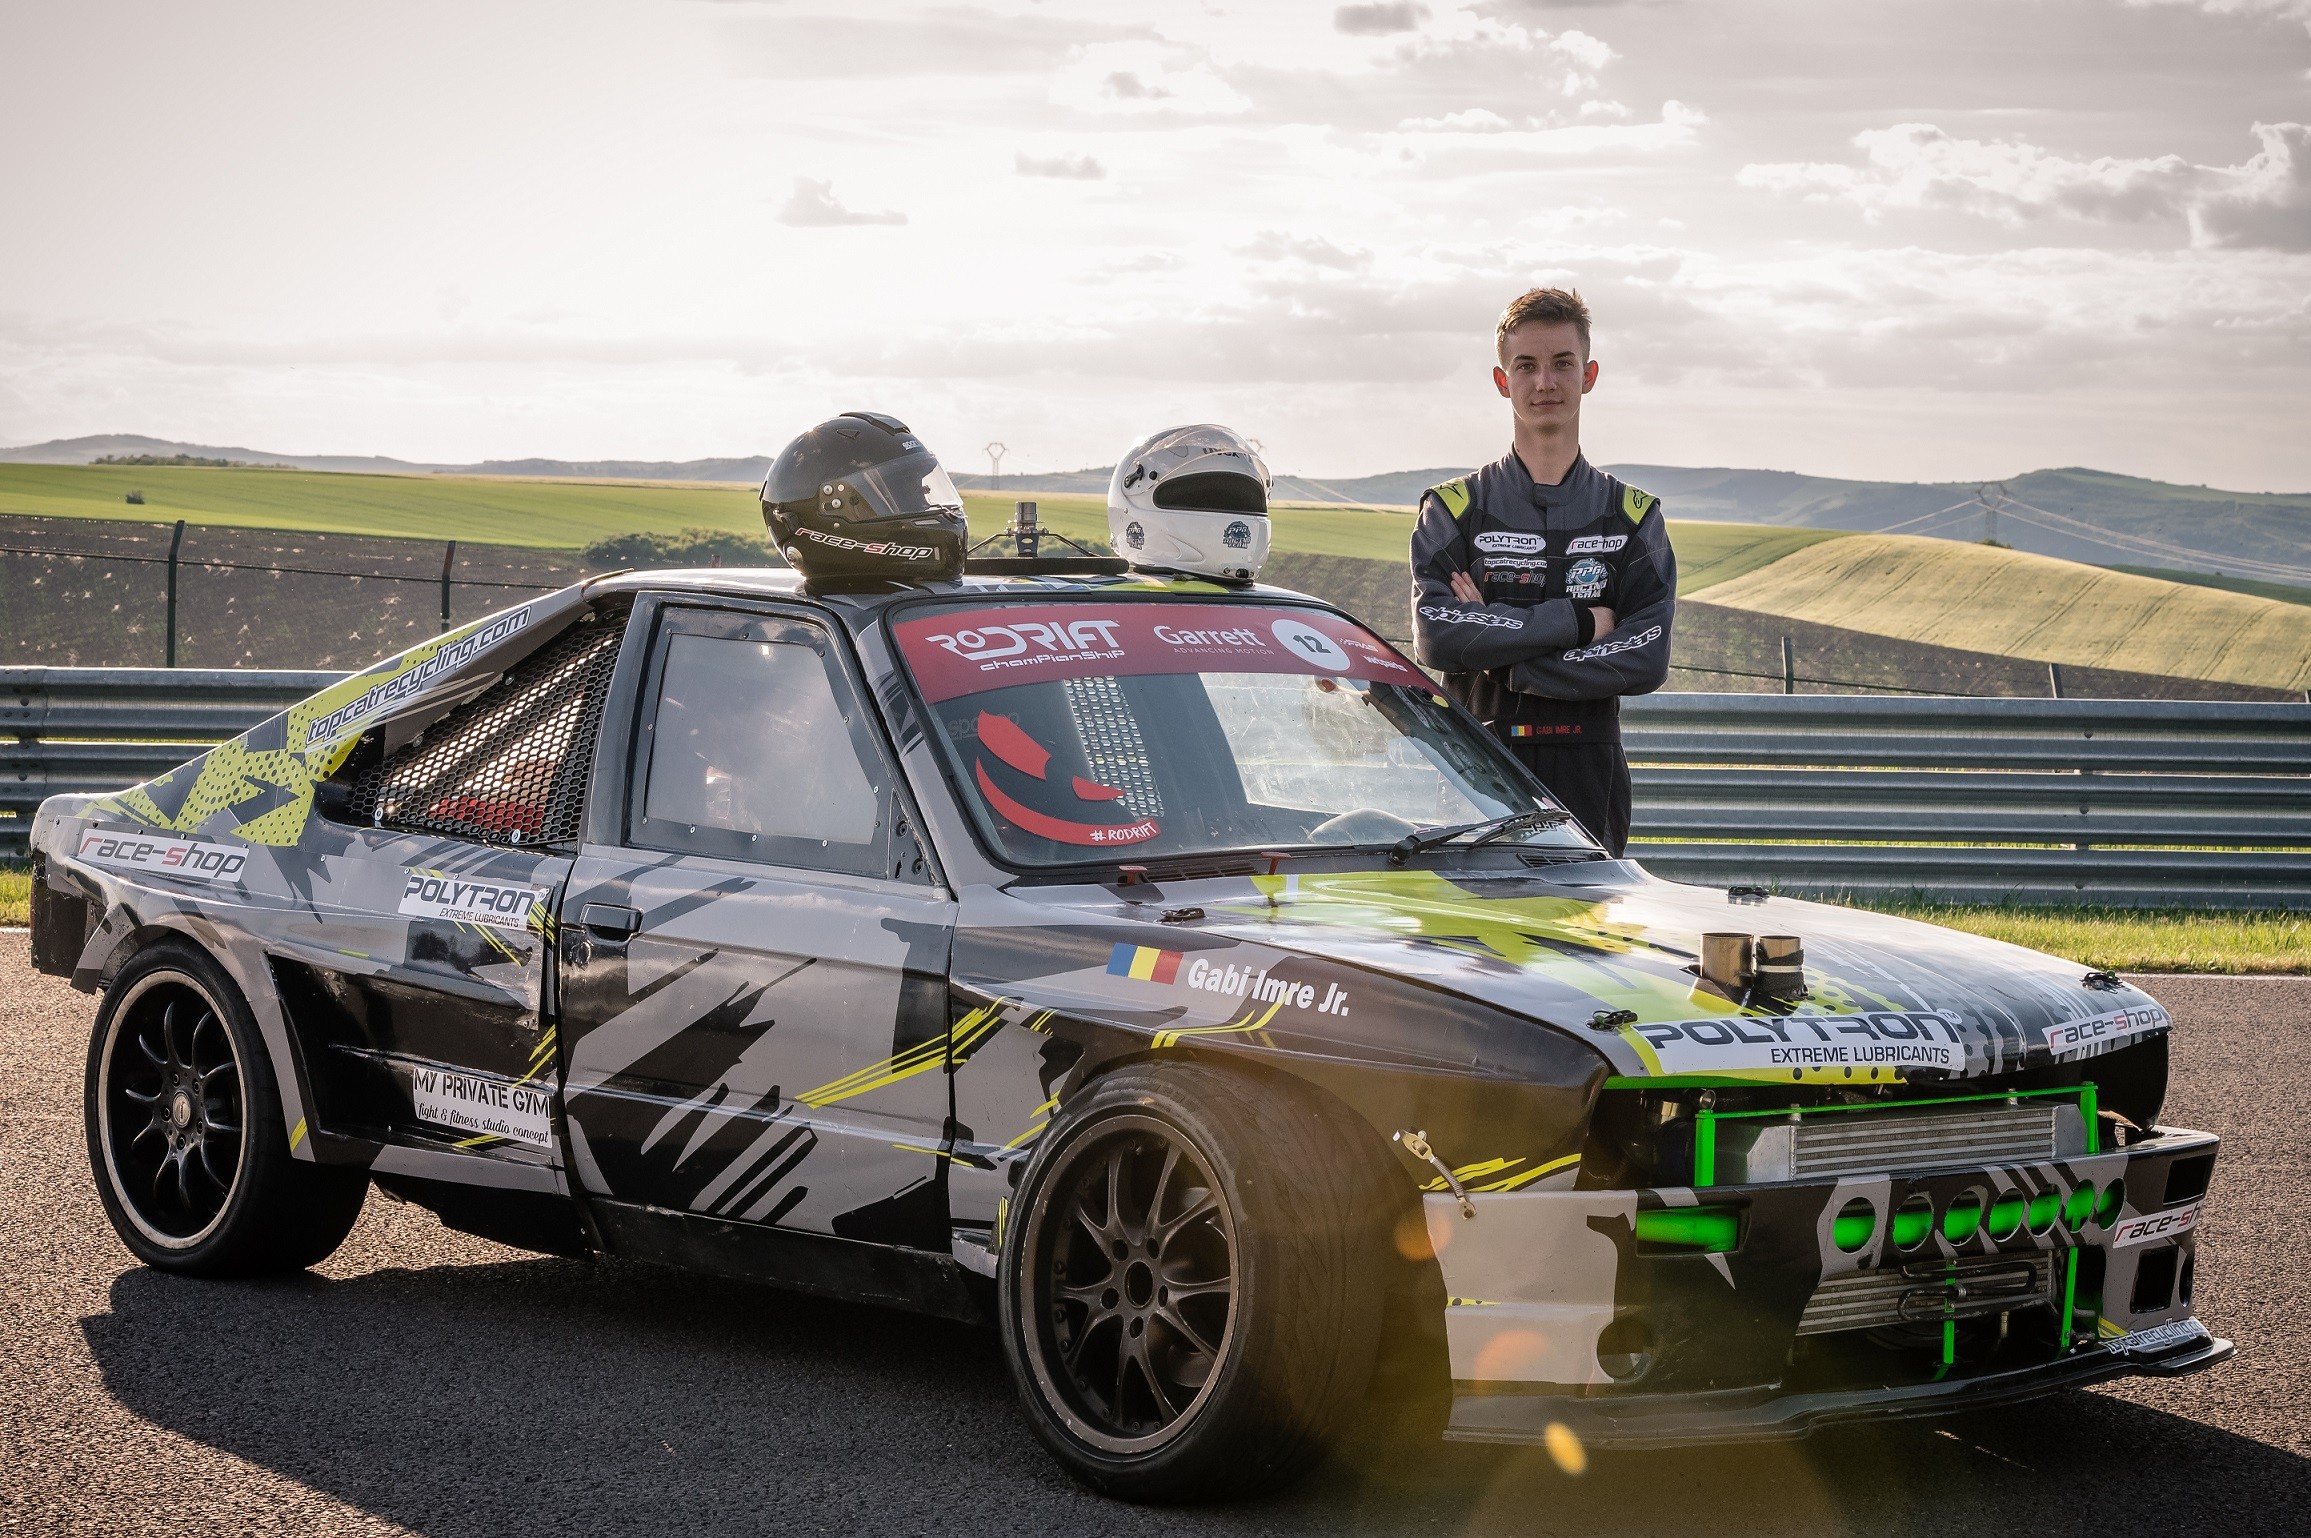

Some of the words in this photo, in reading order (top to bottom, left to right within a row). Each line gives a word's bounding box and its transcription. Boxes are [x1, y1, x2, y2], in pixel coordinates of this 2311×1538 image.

[794, 527, 934, 560] race-shop
[1479, 535, 1537, 546] POLYTRON
[1153, 625, 1267, 647] Garrett
[1293, 635, 1331, 654] 12
[306, 605, 531, 745] topcatrecycling.com
[79, 836, 246, 878] race-shop
[403, 877, 536, 915] POLYTRON
[439, 908, 473, 921] EXTREME
[474, 912, 520, 927] LUBRICANTS
[1188, 958, 1252, 997] Gabi
[1251, 969, 1315, 1009] Imre
[1317, 983, 1350, 1017] Jr.
[1633, 1013, 1960, 1050] POLYTRON
[2049, 1008, 2163, 1049] race-shop
[1771, 1047, 1848, 1064] EXTREME
[1853, 1046, 1950, 1064] LUBRICANTS
[414, 1068, 438, 1093] MY
[442, 1073, 509, 1109] PRIVATE
[512, 1089, 550, 1118] GYM
[417, 1102, 438, 1120] fight
[440, 1108, 448, 1121] &
[450, 1109, 479, 1128] fitness
[482, 1117, 510, 1134] studio
[513, 1125, 549, 1144] concept
